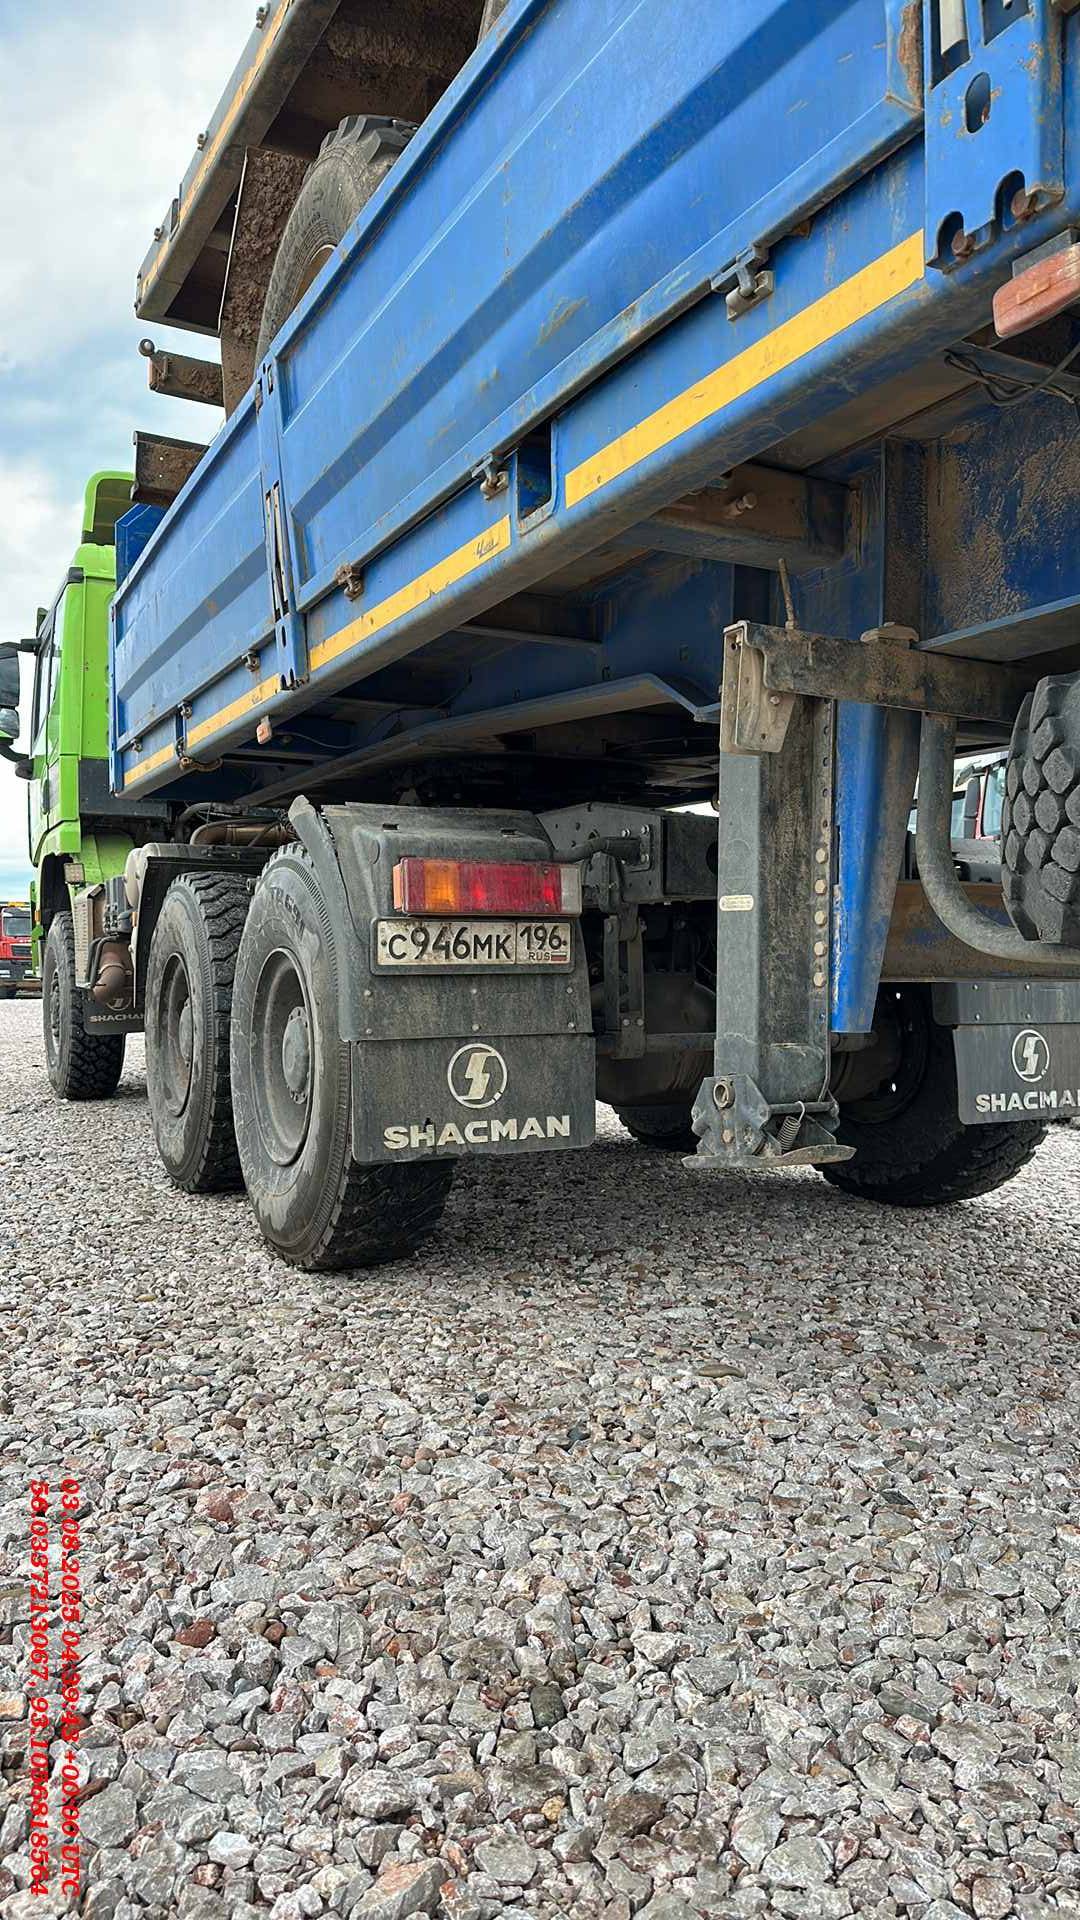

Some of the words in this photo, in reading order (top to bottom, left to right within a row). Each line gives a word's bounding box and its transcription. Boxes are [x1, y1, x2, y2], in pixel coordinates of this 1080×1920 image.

[519, 925, 563, 951] 196
[528, 951, 550, 961] RUS
[975, 1088, 1080, 1113] SHACMA
[383, 1115, 570, 1150] SHACMAN
